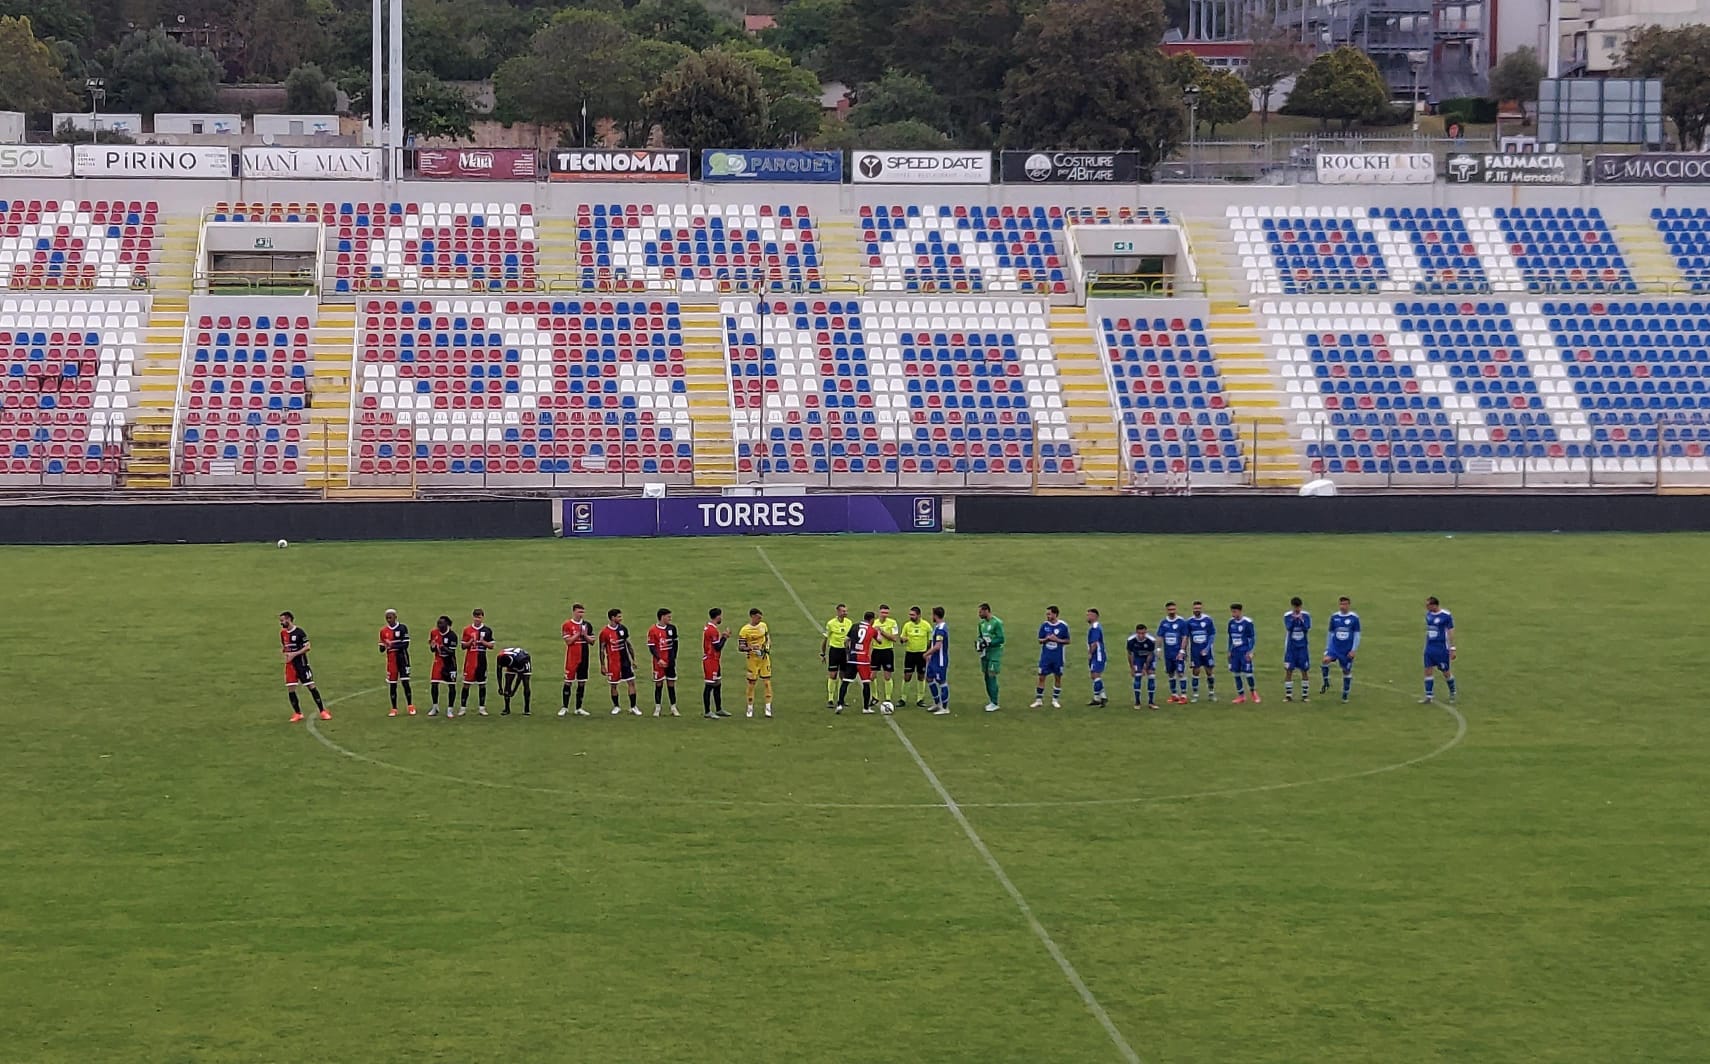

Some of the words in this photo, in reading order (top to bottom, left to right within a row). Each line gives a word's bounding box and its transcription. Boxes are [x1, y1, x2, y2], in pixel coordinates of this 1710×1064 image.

[557, 152, 680, 172] TECNOMAT
[750, 157, 835, 173] PARQUET
[886, 156, 939, 170] SPEED
[942, 156, 983, 170] DATE
[1484, 155, 1565, 169] FARMACIA
[697, 502, 806, 528] TORRES
[857, 628, 867, 644] 9
